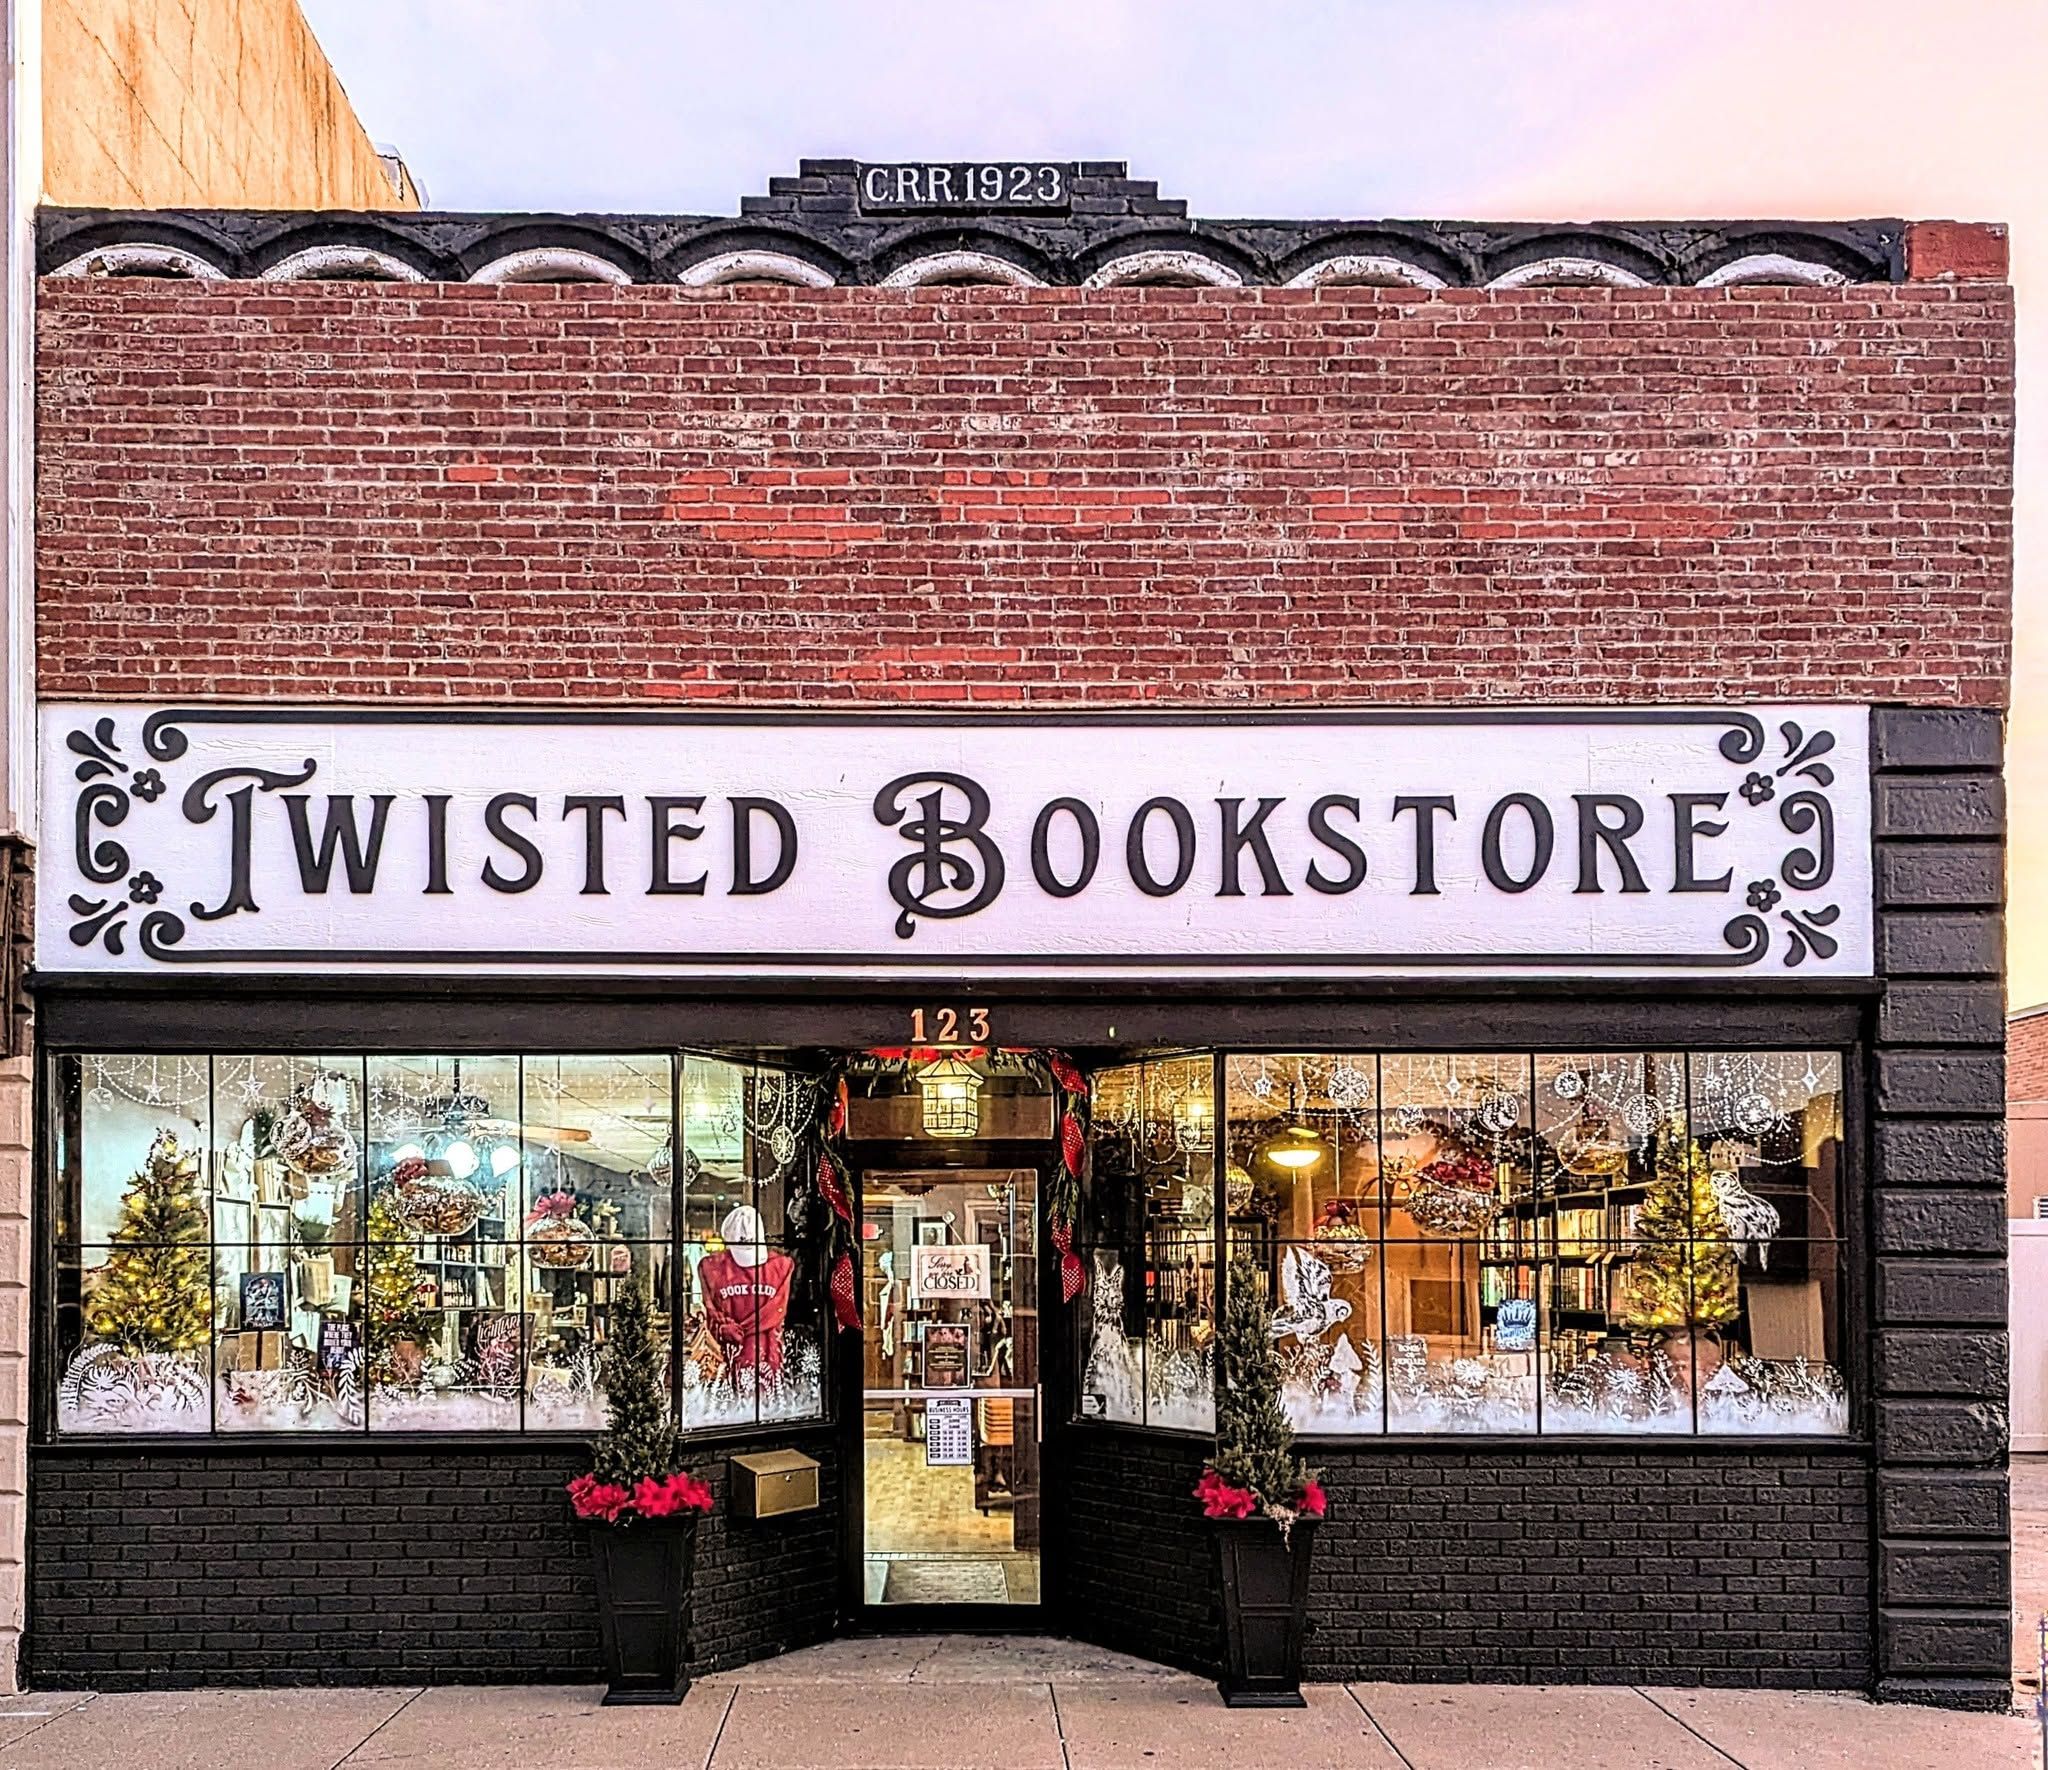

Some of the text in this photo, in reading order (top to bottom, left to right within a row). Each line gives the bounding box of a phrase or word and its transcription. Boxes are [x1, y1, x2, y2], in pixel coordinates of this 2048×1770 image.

[964, 166, 1061, 202] 1923
[183, 758, 1734, 939] TWISTED BOOKSTORE
[911, 1008, 990, 1041] 123
[720, 1284, 749, 1299] BOOK
[923, 1276, 976, 1290] CLOSED
